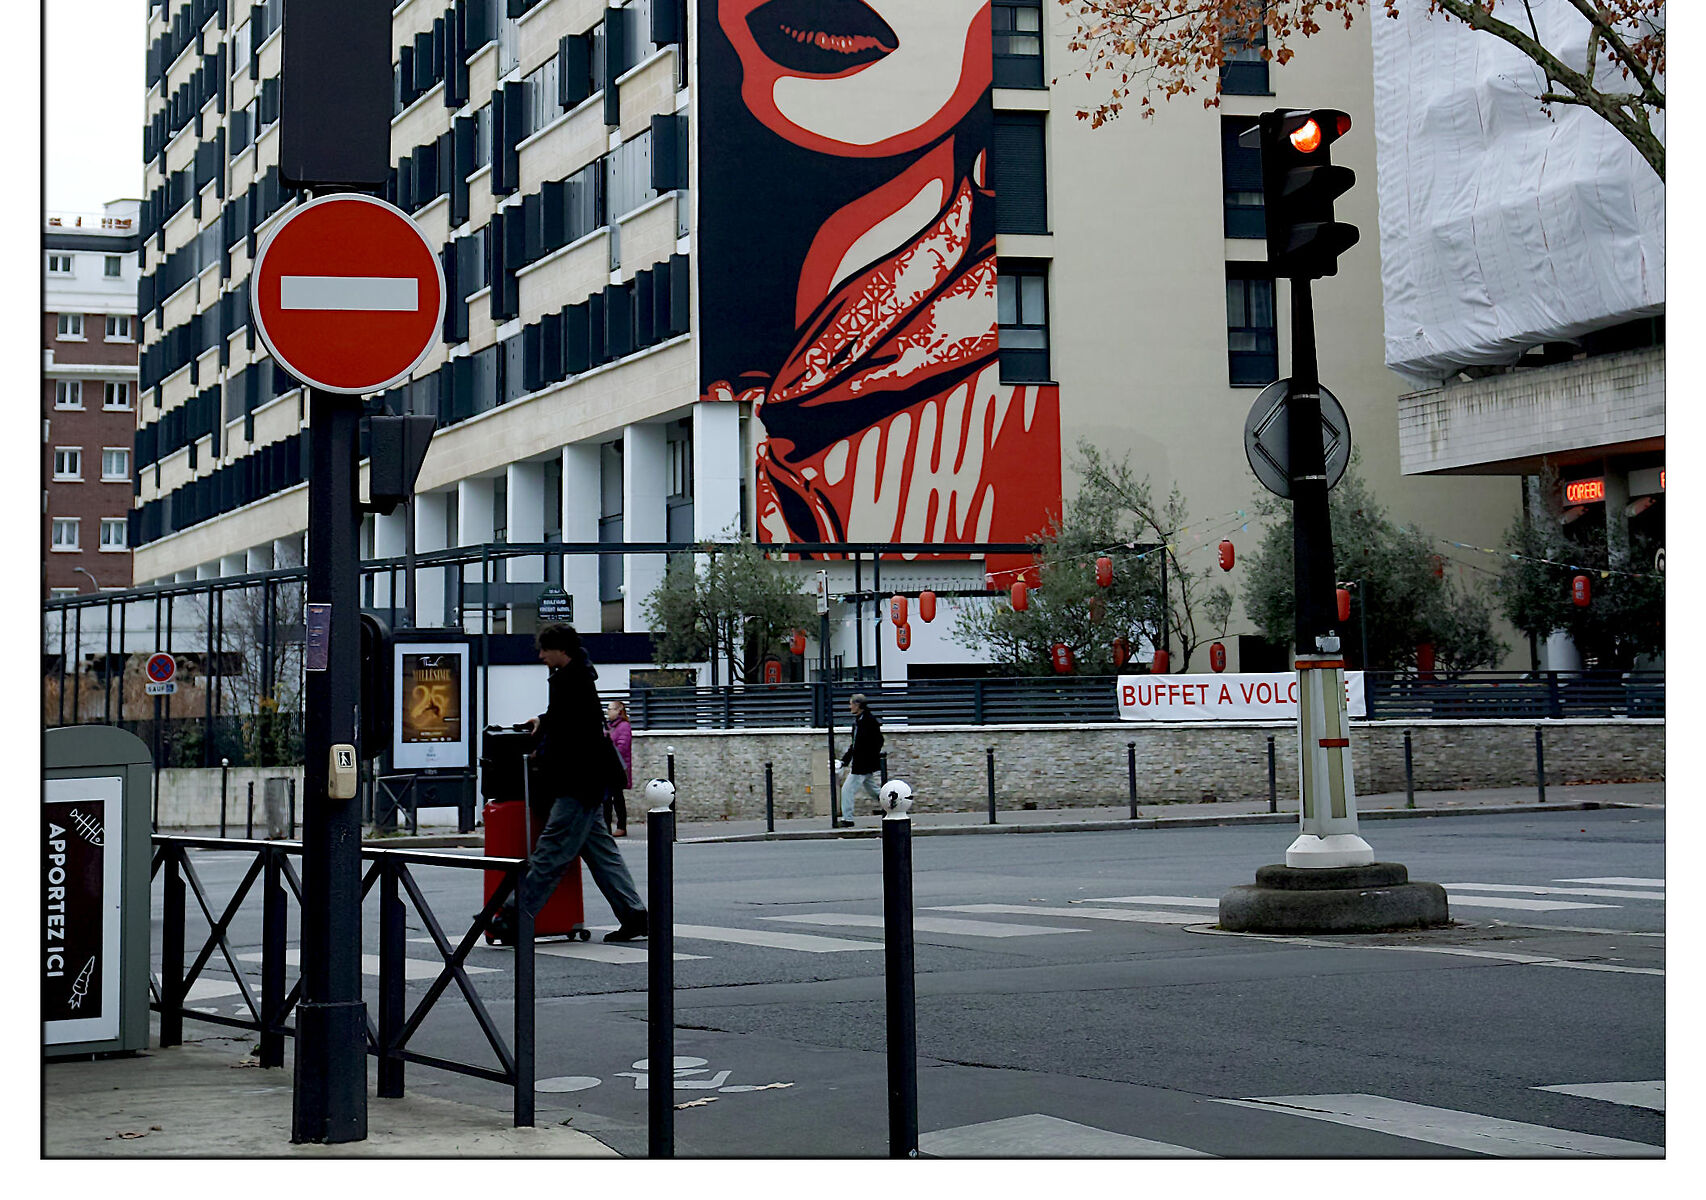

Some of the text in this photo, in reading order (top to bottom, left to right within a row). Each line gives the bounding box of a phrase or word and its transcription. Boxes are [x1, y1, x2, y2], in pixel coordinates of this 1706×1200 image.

[410, 684, 450, 719] 25
[1122, 684, 1209, 706] BUFFET
[1217, 683, 1233, 705] A
[46, 822, 66, 977] APPORTEZ ICI
